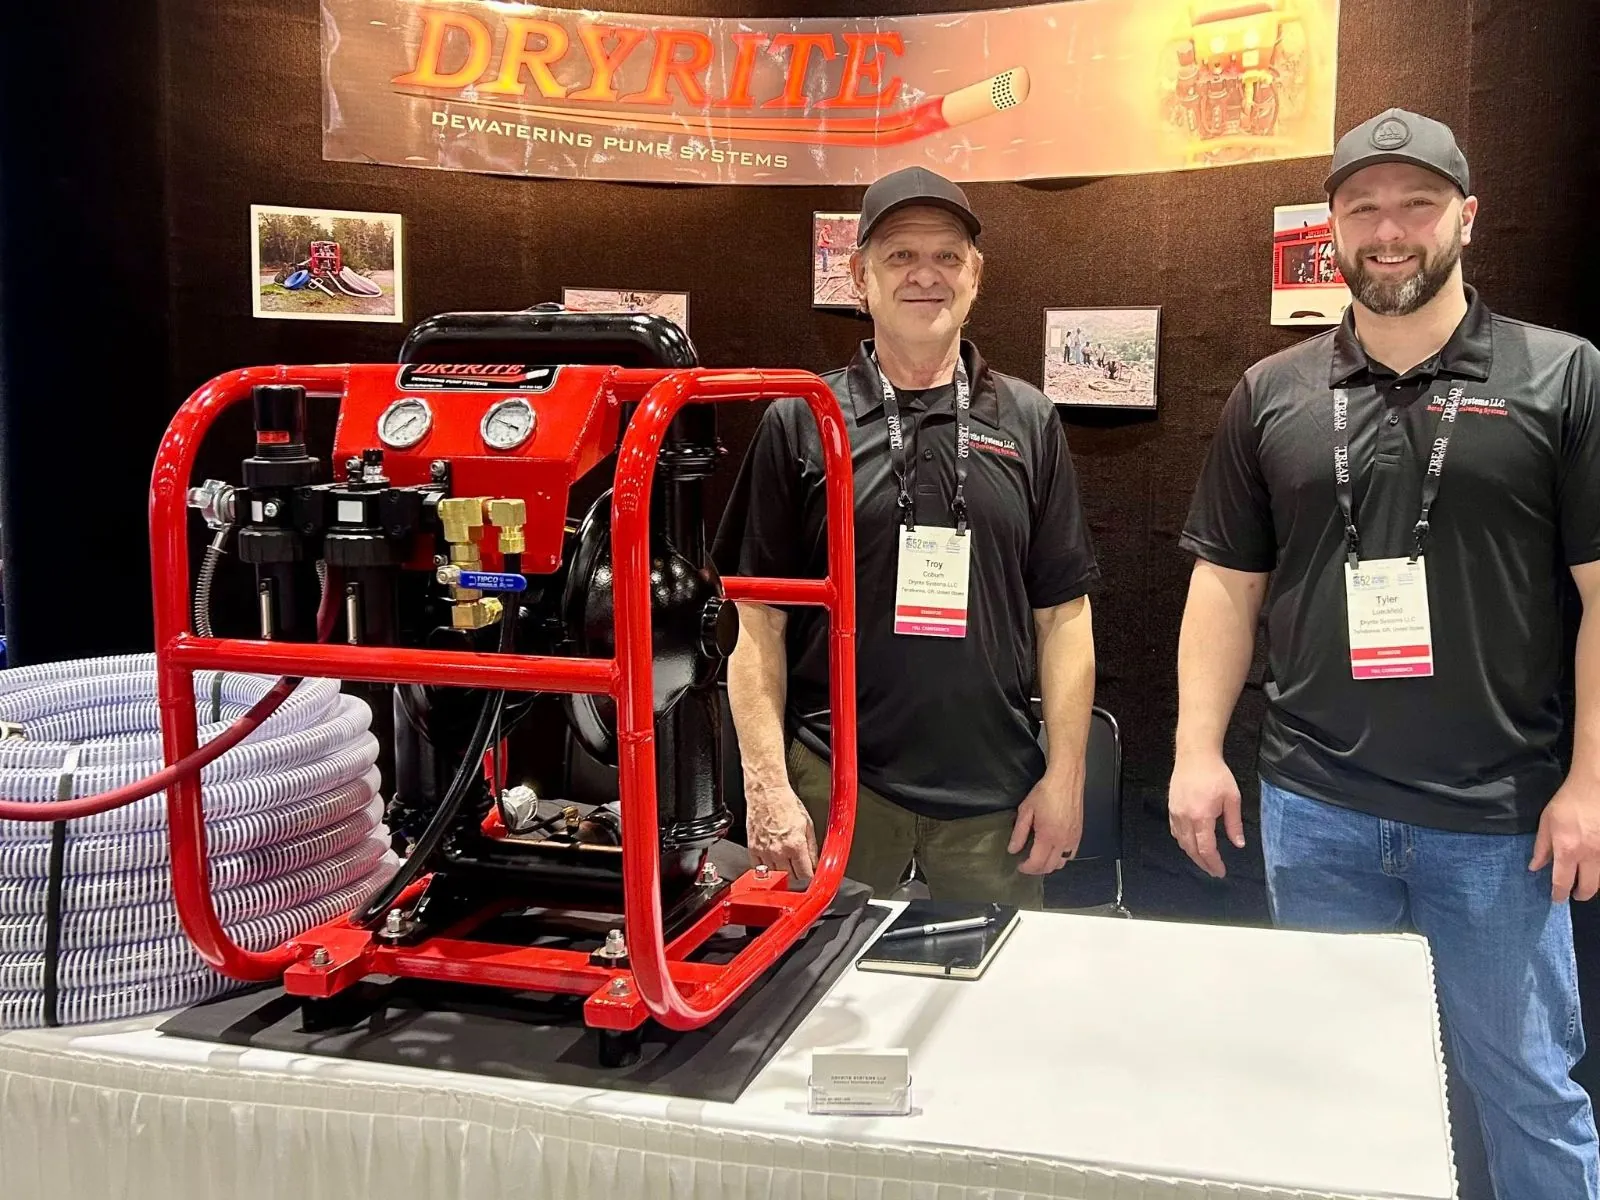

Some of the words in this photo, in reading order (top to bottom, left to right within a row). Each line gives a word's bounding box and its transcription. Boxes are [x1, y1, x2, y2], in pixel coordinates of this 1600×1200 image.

[390, 7, 906, 109] DRYRITE
[431, 111, 593, 148] DEWATERING
[603, 136, 673, 156] PUMP
[679, 145, 788, 169] SYSTEMS
[411, 364, 526, 375] DRYRITE
[1441, 387, 1460, 421] TREAD
[1489, 398, 1506, 408] LLC
[1338, 445, 1350, 484] TREAD
[1428, 437, 1444, 475] TREAD
[925, 559, 944, 569] Troy
[477, 575, 499, 584] TIPCO
[1376, 595, 1398, 605] Tyler
